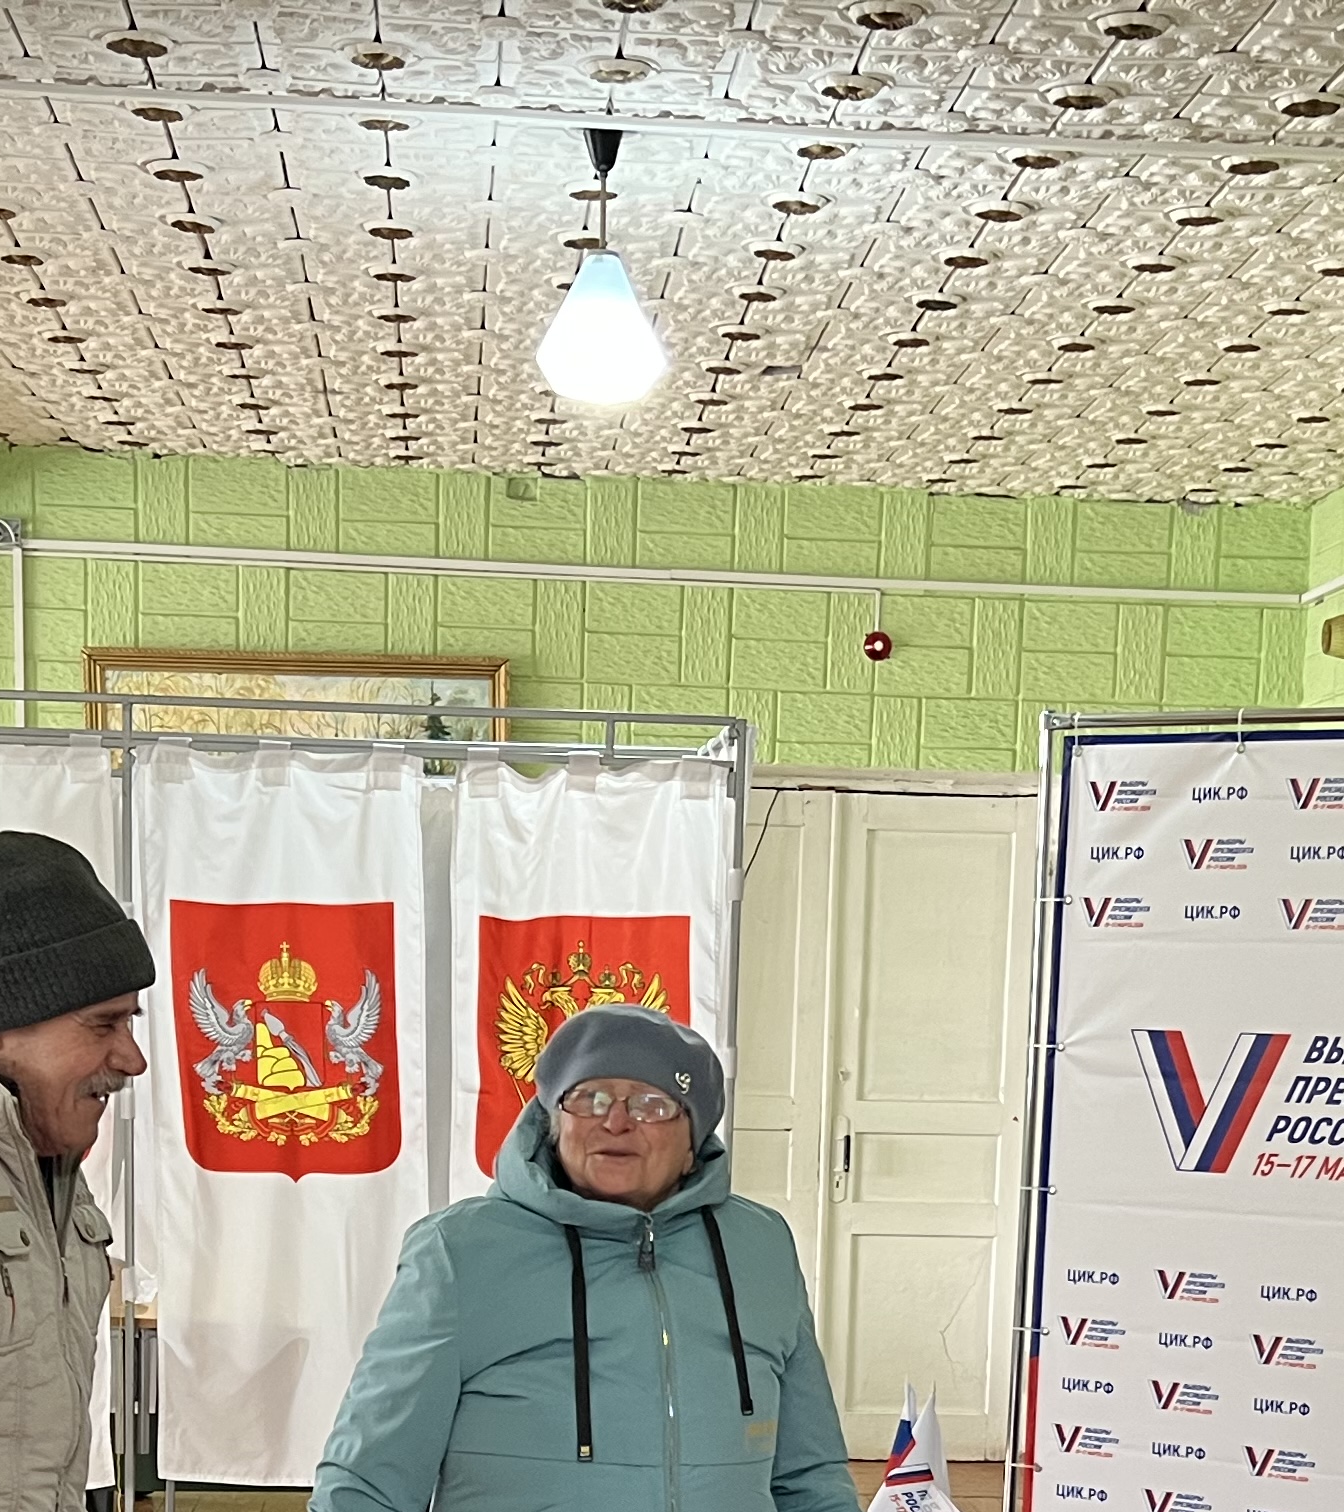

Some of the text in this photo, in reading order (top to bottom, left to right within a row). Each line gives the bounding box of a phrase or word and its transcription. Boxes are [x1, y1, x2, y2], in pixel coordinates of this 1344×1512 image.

[1192, 786, 1248, 803] ЦИК.РФ
[1091, 846, 1144, 863] ЦИК.РФ
[1185, 906, 1240, 921] ЦИК.РФ
[1068, 1269, 1119, 1285] ЦИК.РФ
[1261, 1285, 1317, 1302] ЦИК.РФ
[1159, 1333, 1212, 1349] ЦИК.РФ
[1062, 1377, 1114, 1394] ЦИК.РФ
[1254, 1398, 1310, 1416] ЦИК.РФ
[1152, 1442, 1205, 1460] ЦИК.РФ
[1056, 1484, 1107, 1502] ЦИК.РФ
